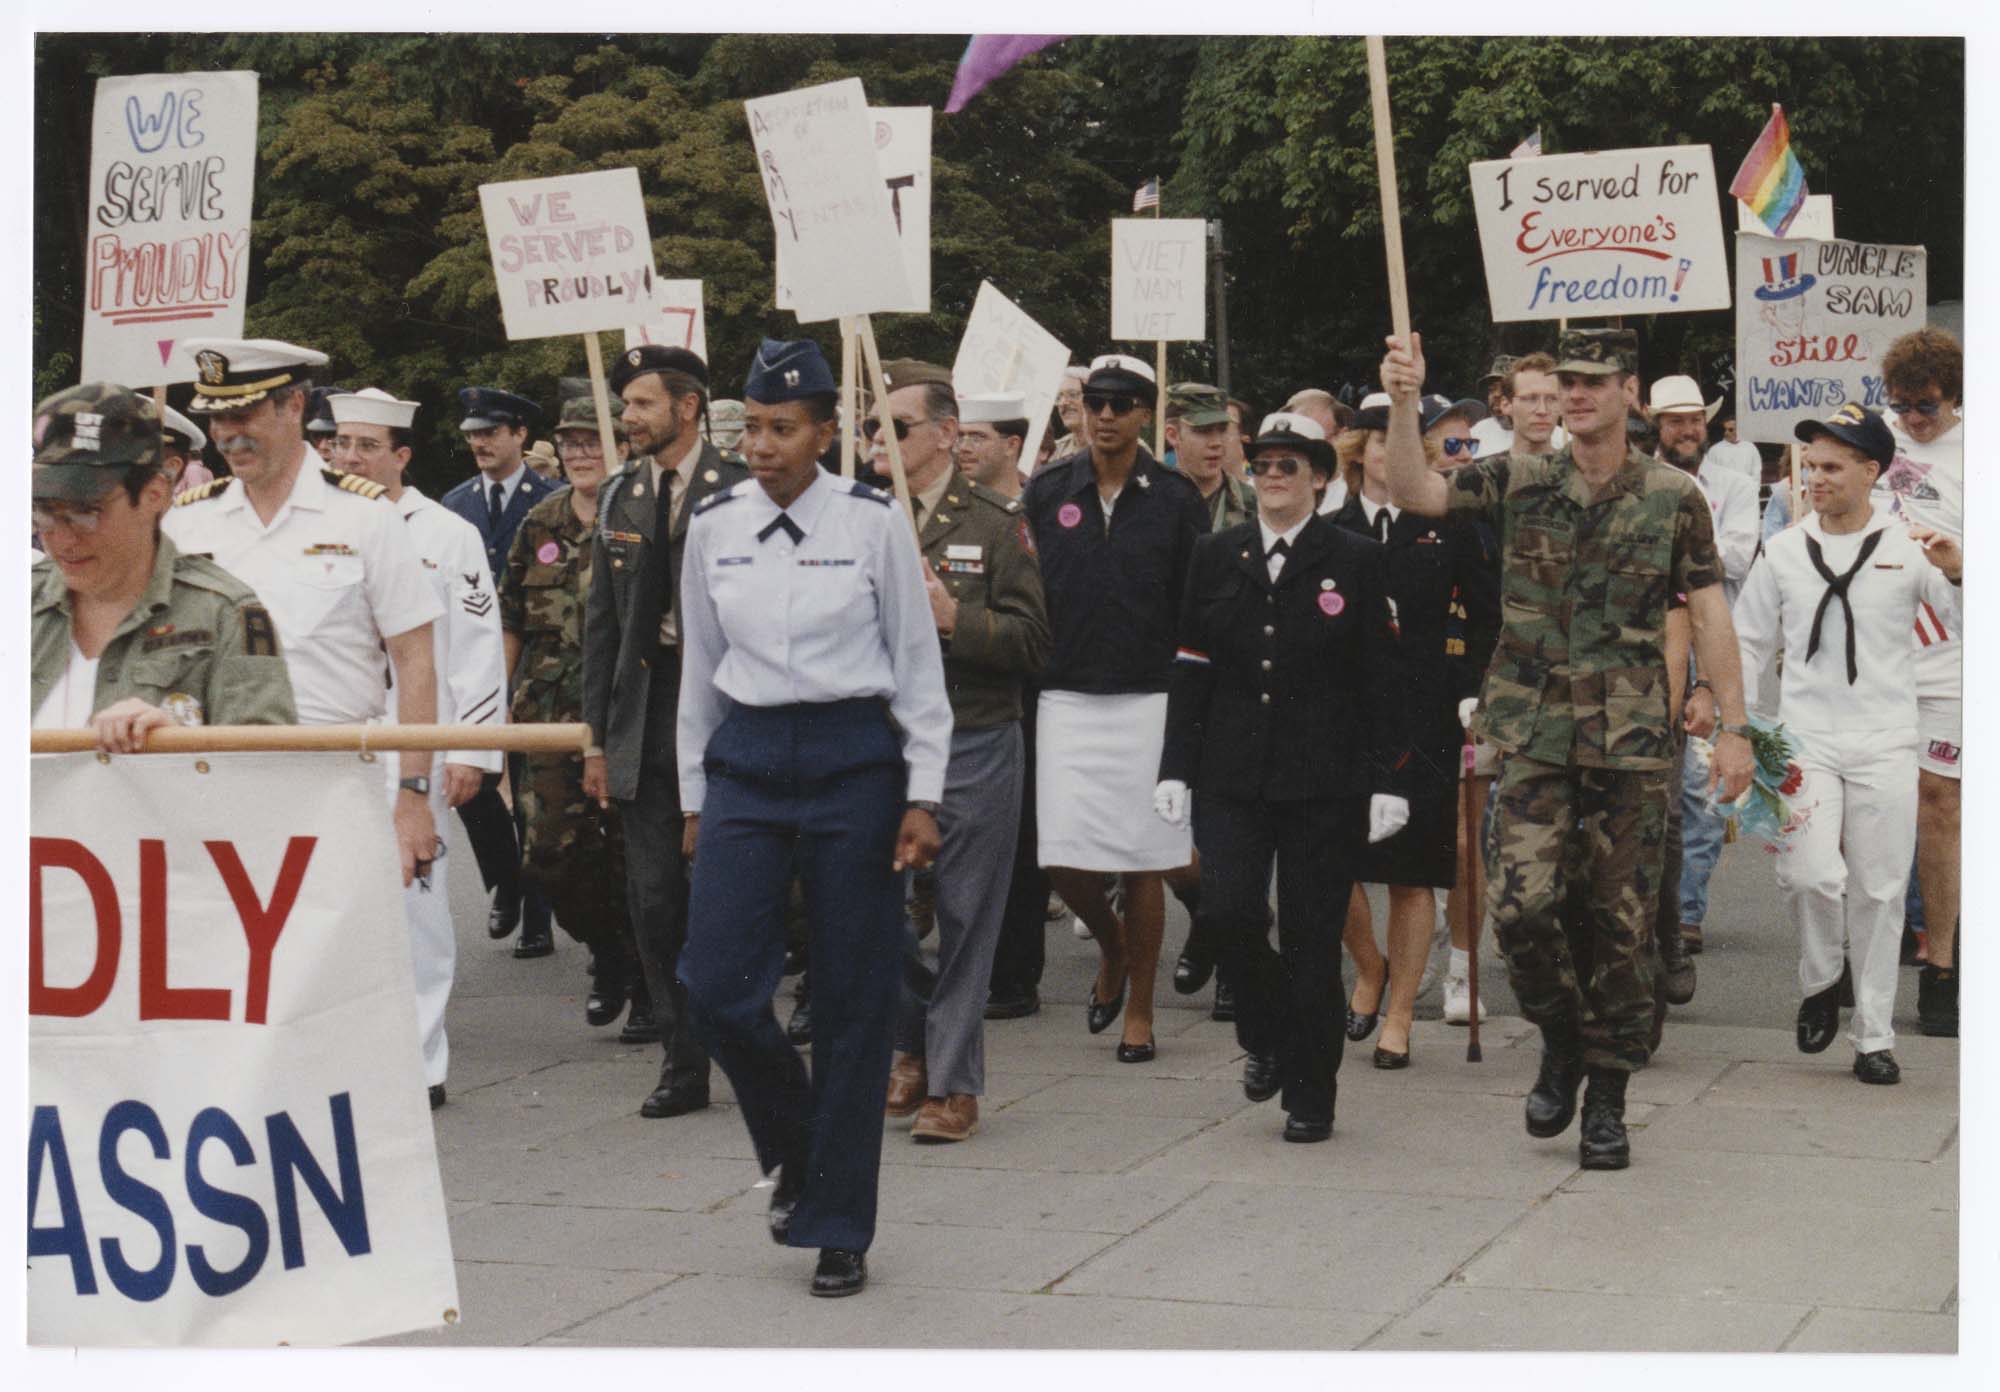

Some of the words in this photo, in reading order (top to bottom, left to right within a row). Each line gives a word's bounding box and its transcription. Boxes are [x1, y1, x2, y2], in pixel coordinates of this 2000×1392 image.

[125, 88, 205, 154] WE
[1496, 166, 1513, 212] I
[1533, 163, 1640, 204] served
[1658, 159, 1698, 195] for
[507, 191, 576, 227] WE
[499, 224, 634, 273] SERVED
[1516, 210, 1677, 254] Everyone's
[1120, 239, 1193, 272] VIET
[1817, 243, 1917, 279] UNCLE
[524, 264, 653, 308] PROUDLY!
[1131, 277, 1184, 304] NAM
[1528, 258, 1692, 310] freedom!
[1825, 284, 1913, 320] SAM
[1133, 312, 1178, 337] VET
[1748, 375, 1846, 411] WANTS
[27, 1091, 372, 1302] ASSN
